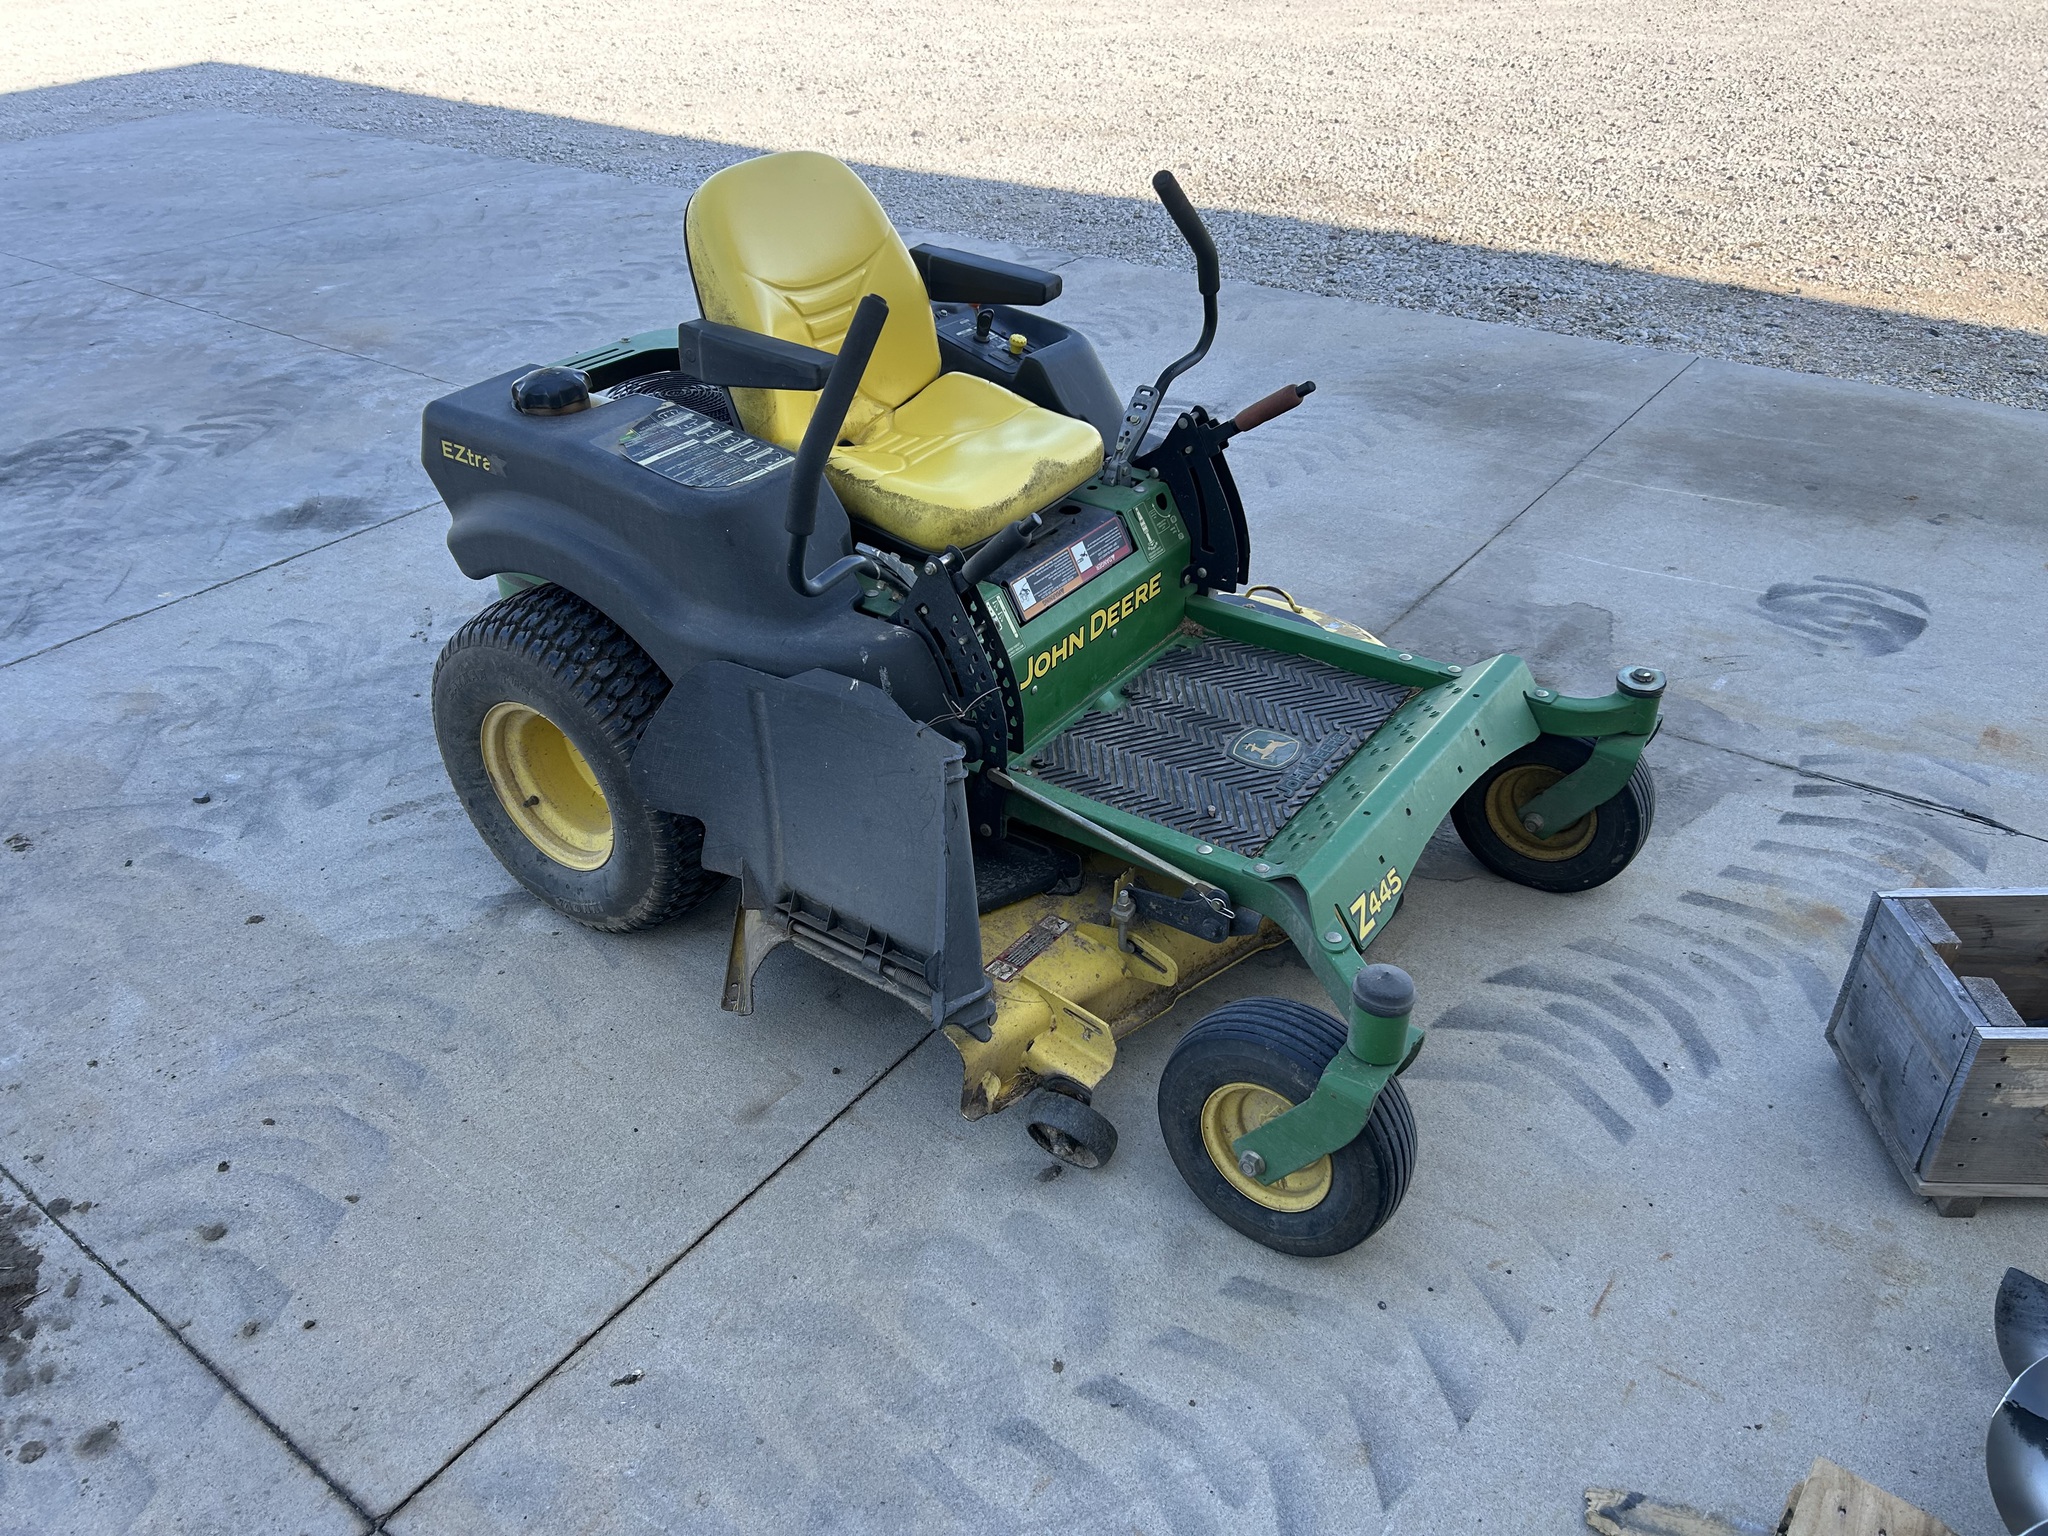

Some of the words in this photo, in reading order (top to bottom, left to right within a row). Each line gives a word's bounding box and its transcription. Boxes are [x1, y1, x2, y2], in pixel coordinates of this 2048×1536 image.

[1095, 554, 1113, 572] DANGER
[1042, 588, 1062, 607] WARNING
[1020, 625, 1085, 690] JOHN
[1089, 571, 1162, 642] DEERE
[1281, 763, 1314, 797] JOHN
[1305, 733, 1349, 766] DEERE
[1349, 866, 1402, 941] Z445
